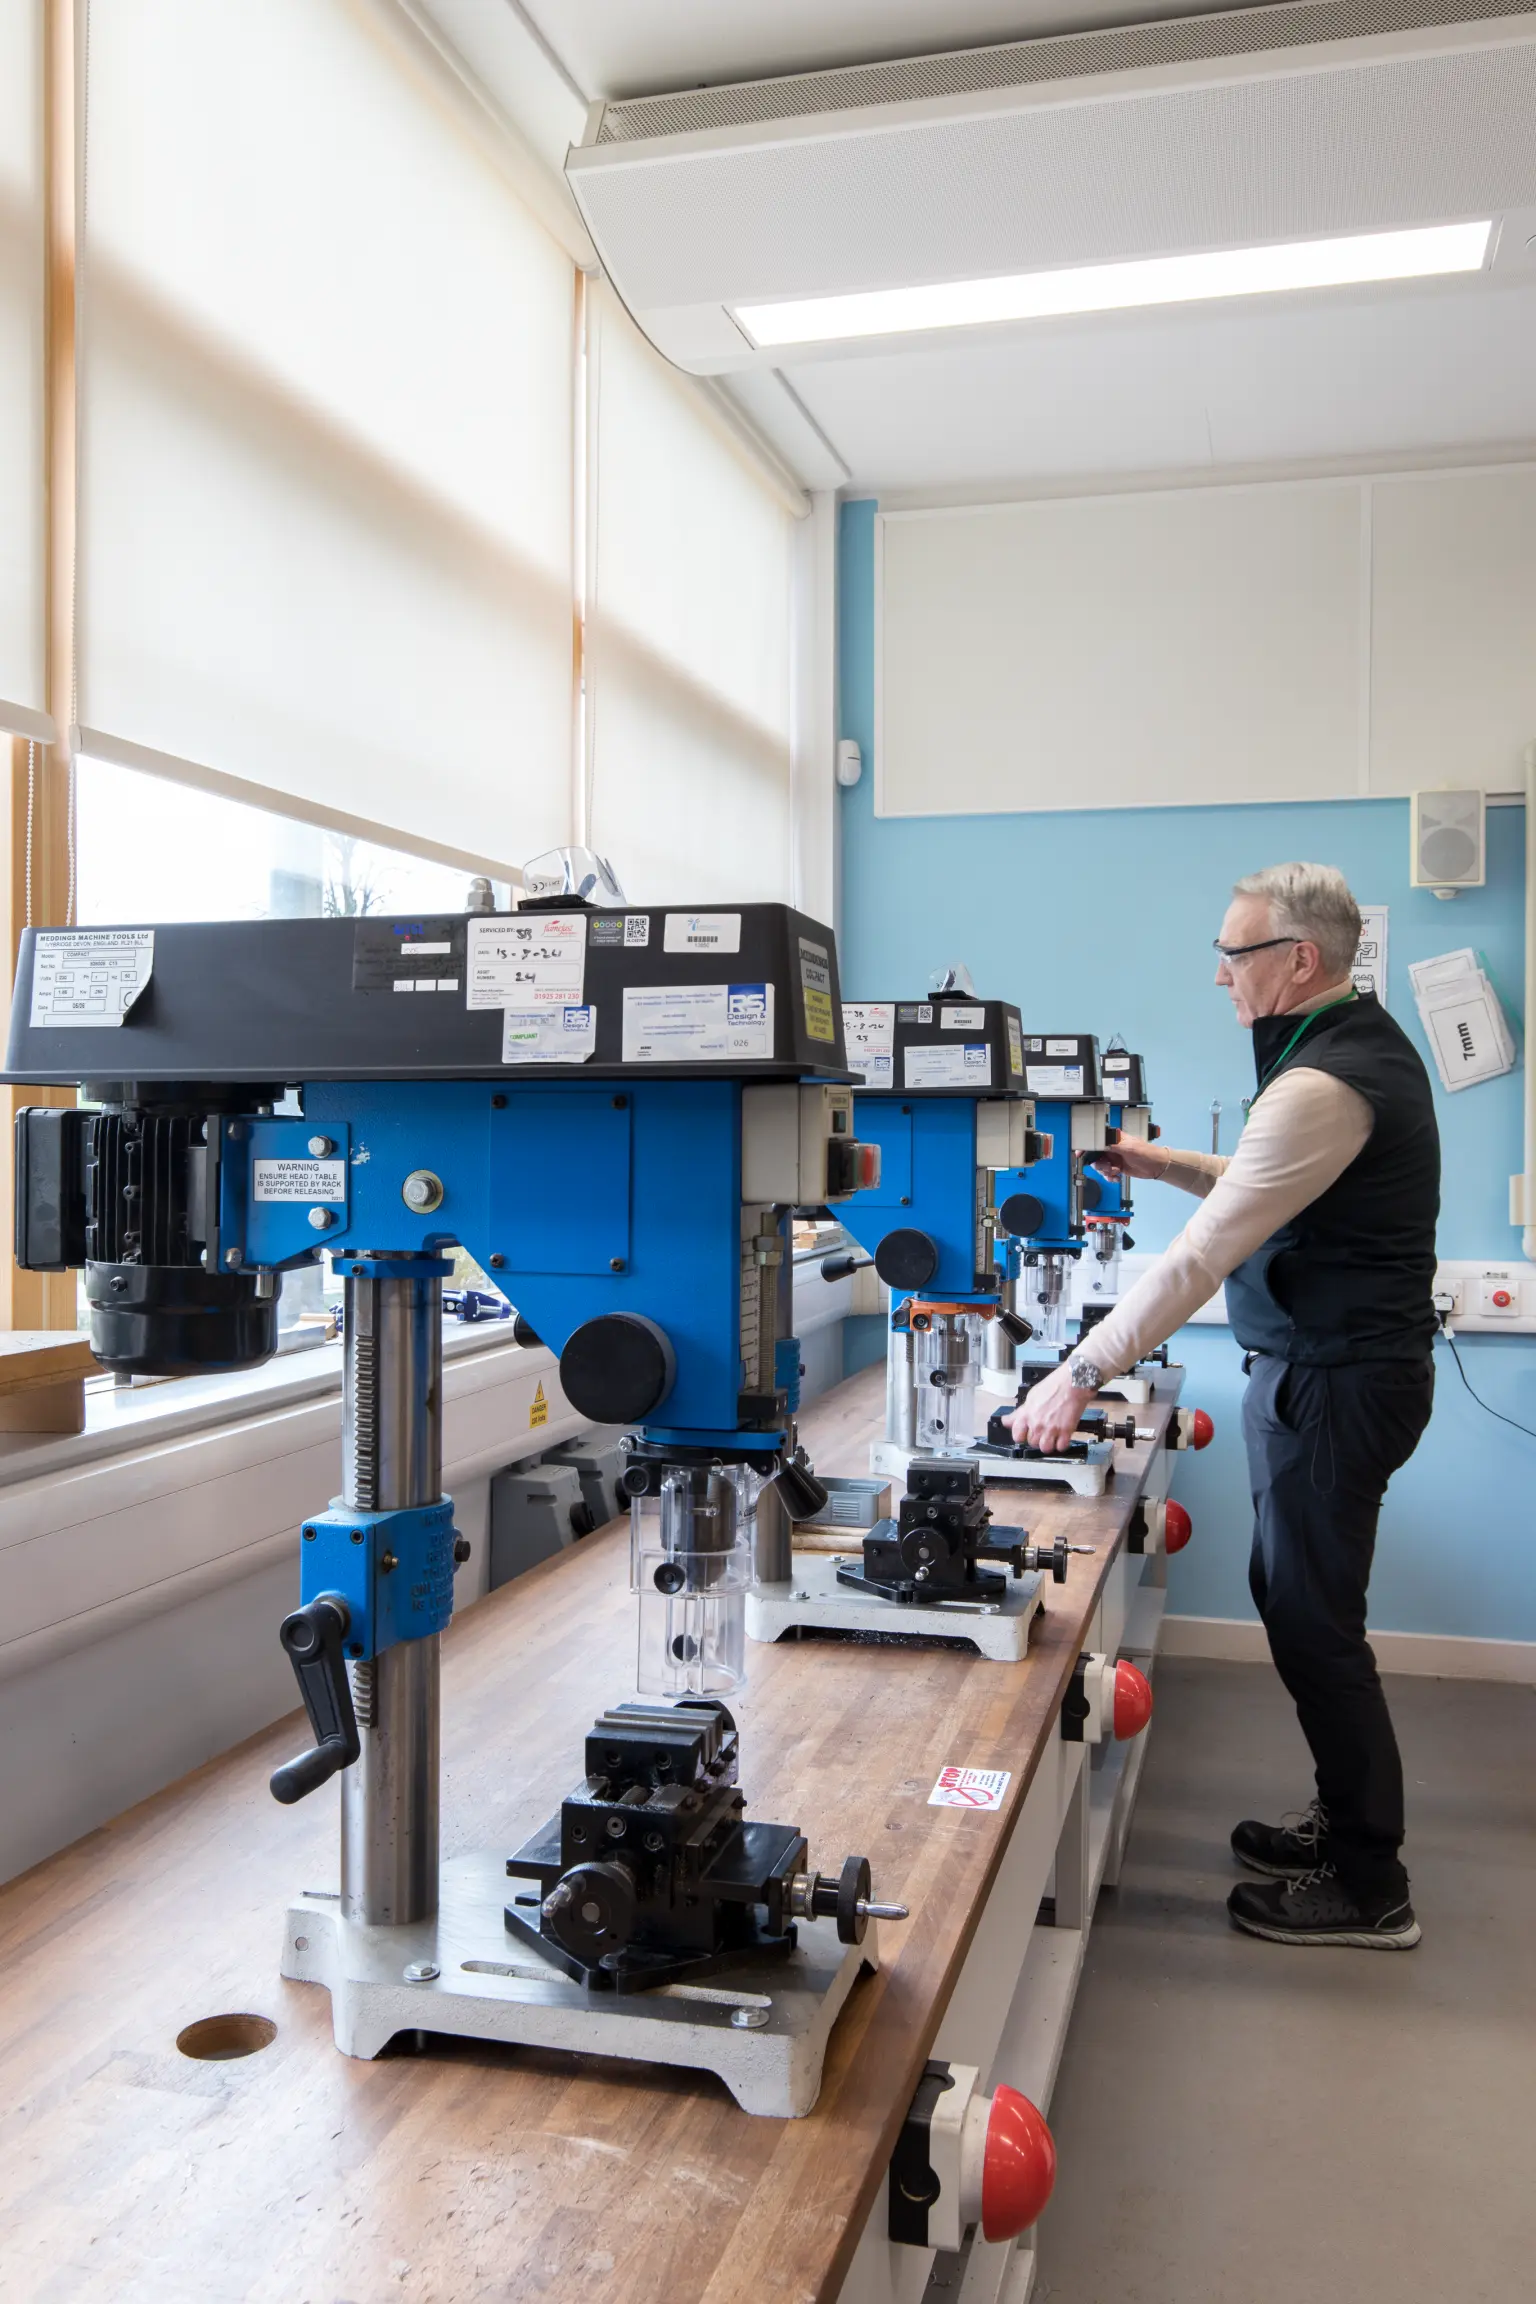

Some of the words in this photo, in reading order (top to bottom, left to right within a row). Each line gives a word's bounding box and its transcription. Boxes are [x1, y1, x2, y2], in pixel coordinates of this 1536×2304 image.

[515, 971, 536, 983] 24
[729, 994, 765, 1013] RS
[727, 1012, 758, 1020] Design
[509, 1032, 538, 1041] COMPLIANT
[1457, 1022, 1476, 1061] 7mm
[733, 1039, 749, 1047] 026
[277, 1163, 320, 1172] WARNING
[265, 1180, 309, 1188] SUPPORTED
[321, 1180, 342, 1188] RACK
[531, 1403, 547, 1414] DANGER
[938, 1767, 962, 1788] STOP
